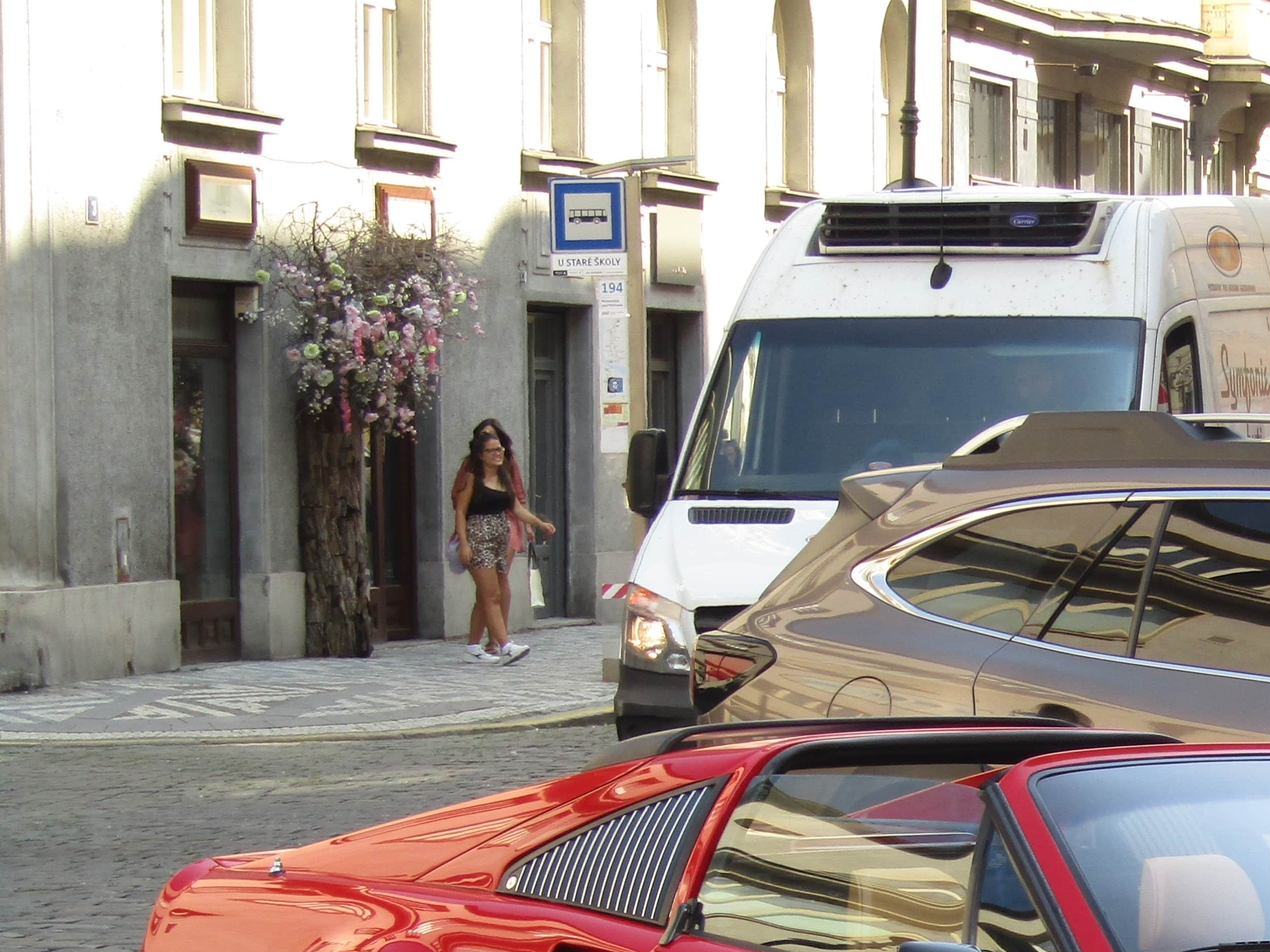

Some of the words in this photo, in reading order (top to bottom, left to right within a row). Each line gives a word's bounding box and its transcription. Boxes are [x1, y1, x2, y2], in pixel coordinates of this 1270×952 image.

[558, 258, 564, 267] U
[566, 257, 593, 267] STARÉ
[594, 257, 621, 267] ŠKOLY
[601, 282, 624, 294] 194
